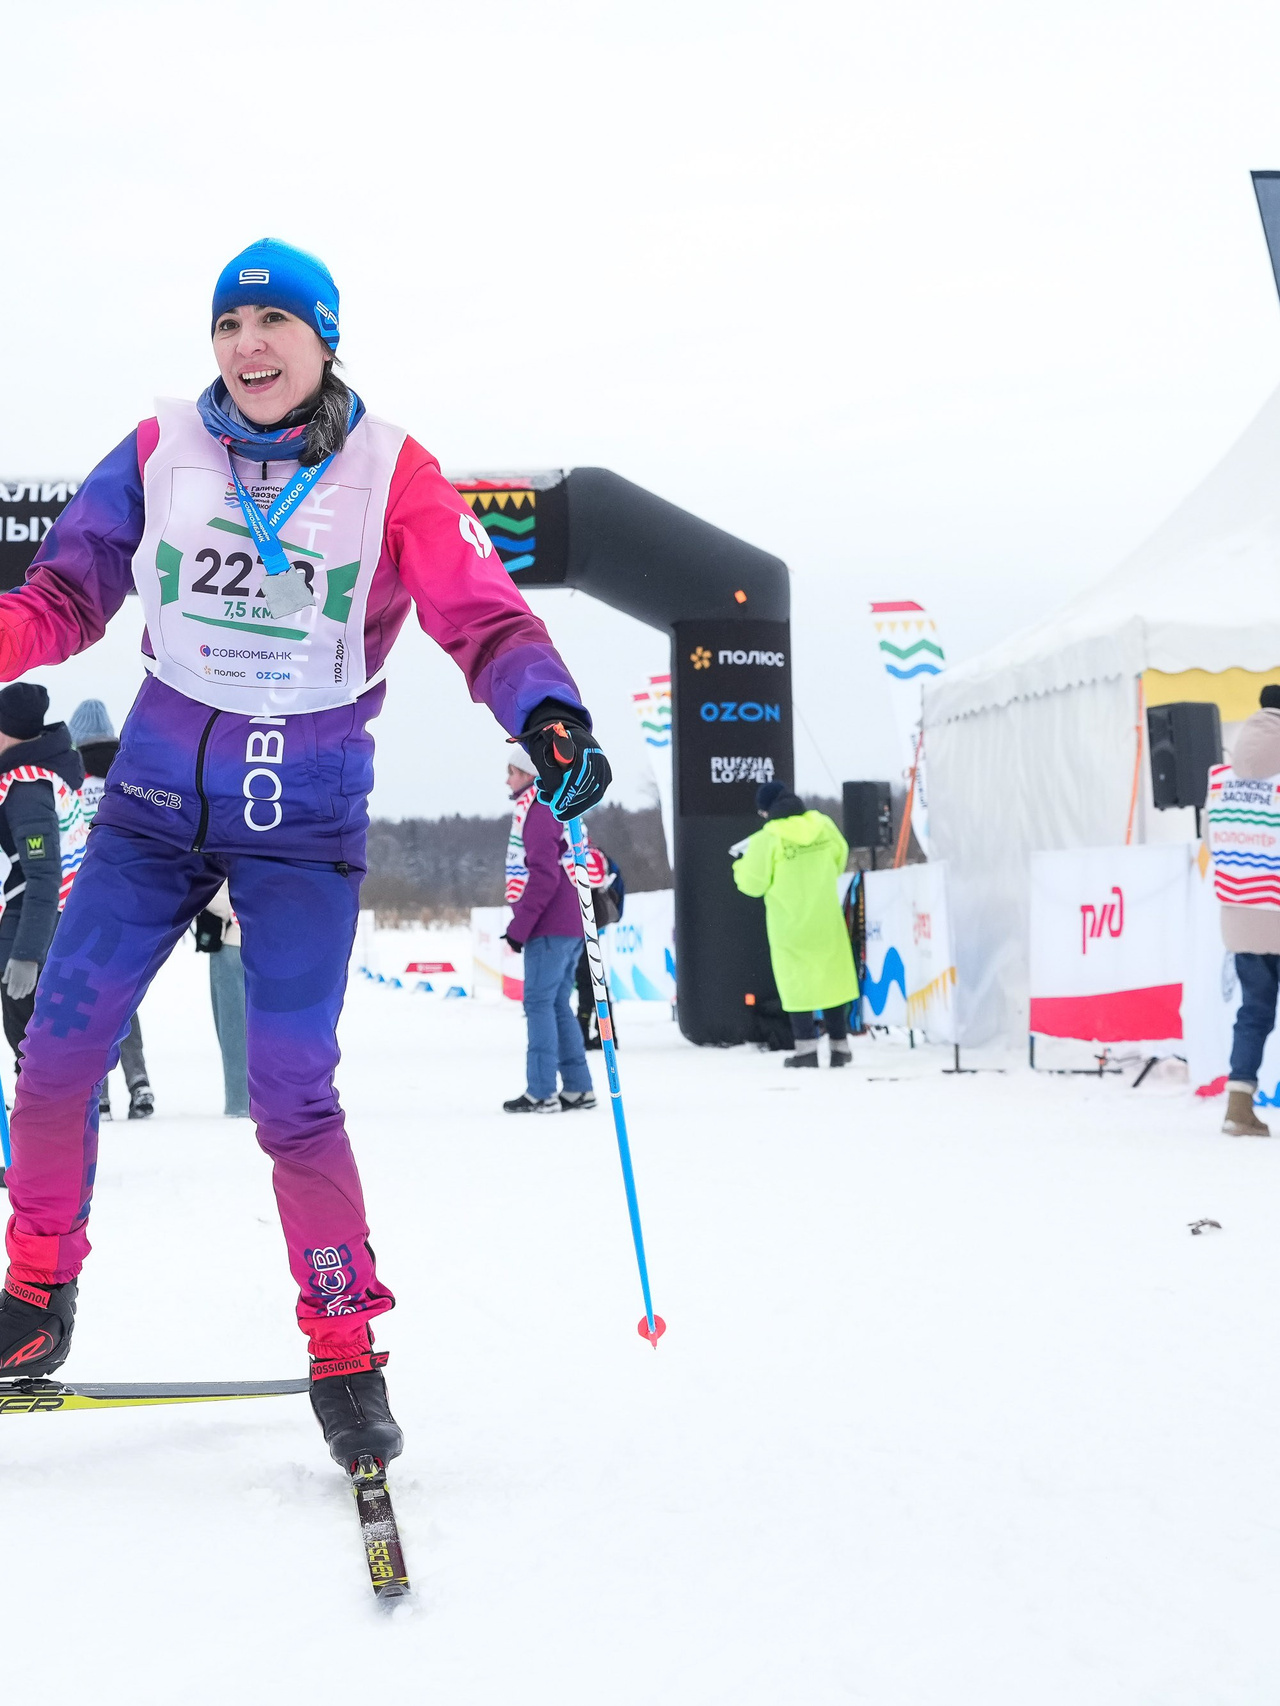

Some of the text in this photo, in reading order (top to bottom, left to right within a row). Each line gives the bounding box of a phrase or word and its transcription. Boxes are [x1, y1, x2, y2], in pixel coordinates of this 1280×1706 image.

[223, 600, 247, 620] 7,5
[212, 647, 293, 661] СОВКОМБАНК
[255, 671, 291, 681] OZON
[700, 702, 781, 723] OZON
